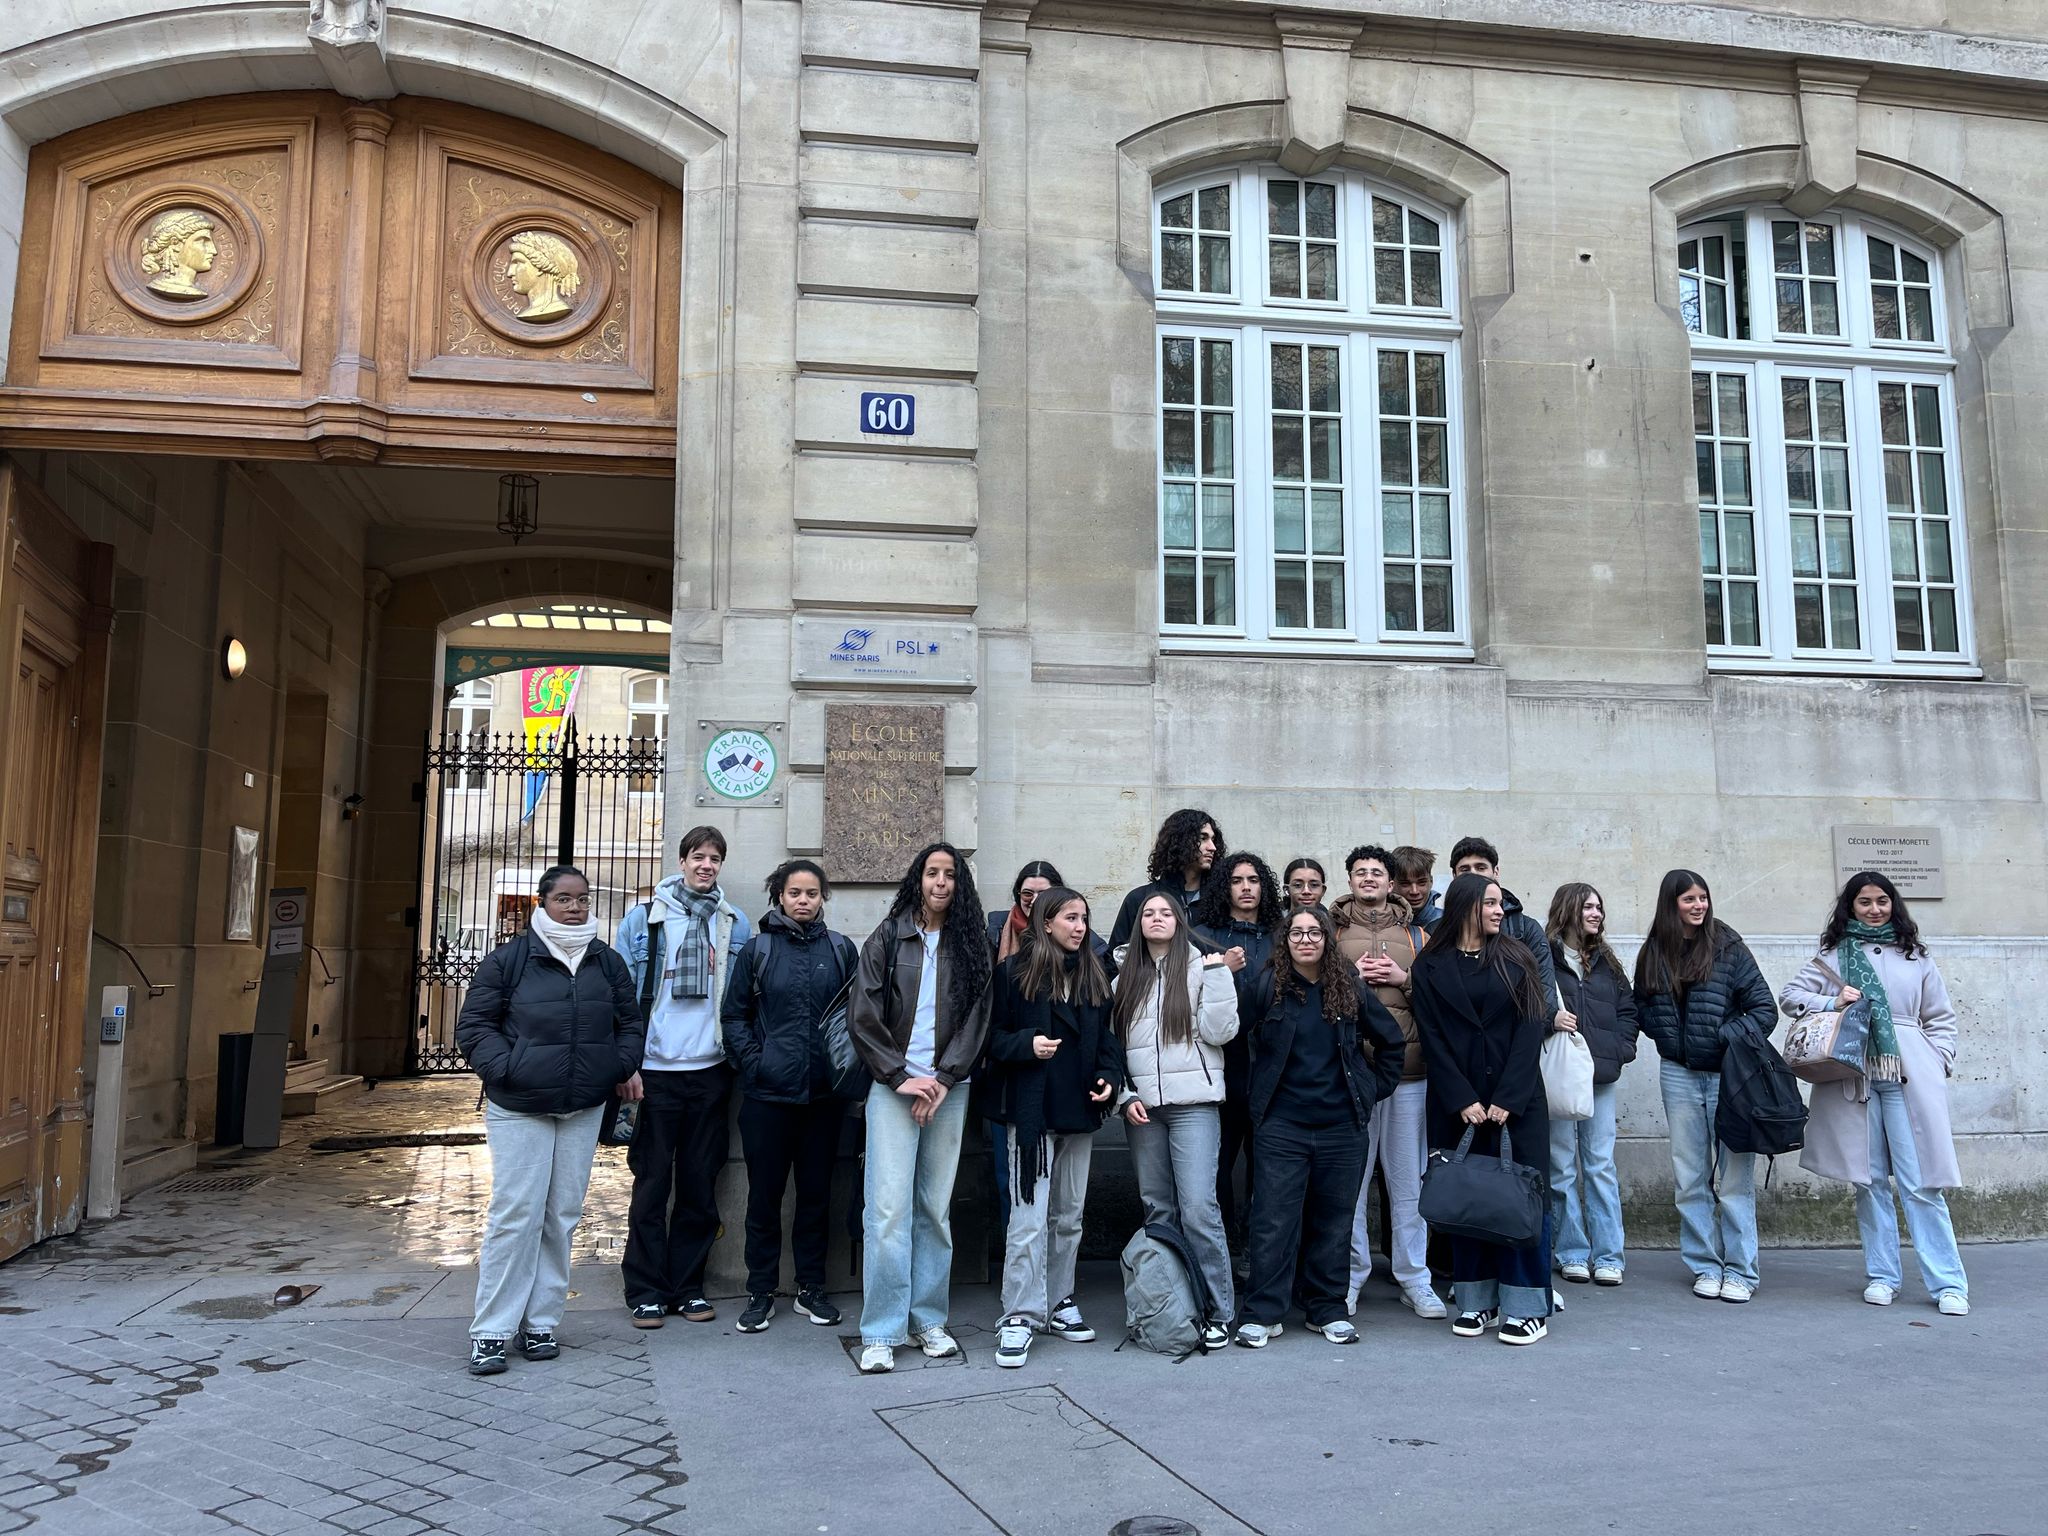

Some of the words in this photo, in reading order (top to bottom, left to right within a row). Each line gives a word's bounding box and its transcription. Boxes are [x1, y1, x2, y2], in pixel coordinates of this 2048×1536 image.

[868, 397, 909, 430] 60
[896, 640, 925, 655] PSL
[830, 653, 855, 662] MINES
[856, 654, 880, 663] PARIS
[714, 735, 768, 756] FRANCE
[830, 750, 884, 761] NATIONALE
[712, 770, 769, 793] RELANCE
[876, 768, 895, 779] DES
[852, 787, 918, 804] MINES
[856, 830, 912, 848] PARIS
